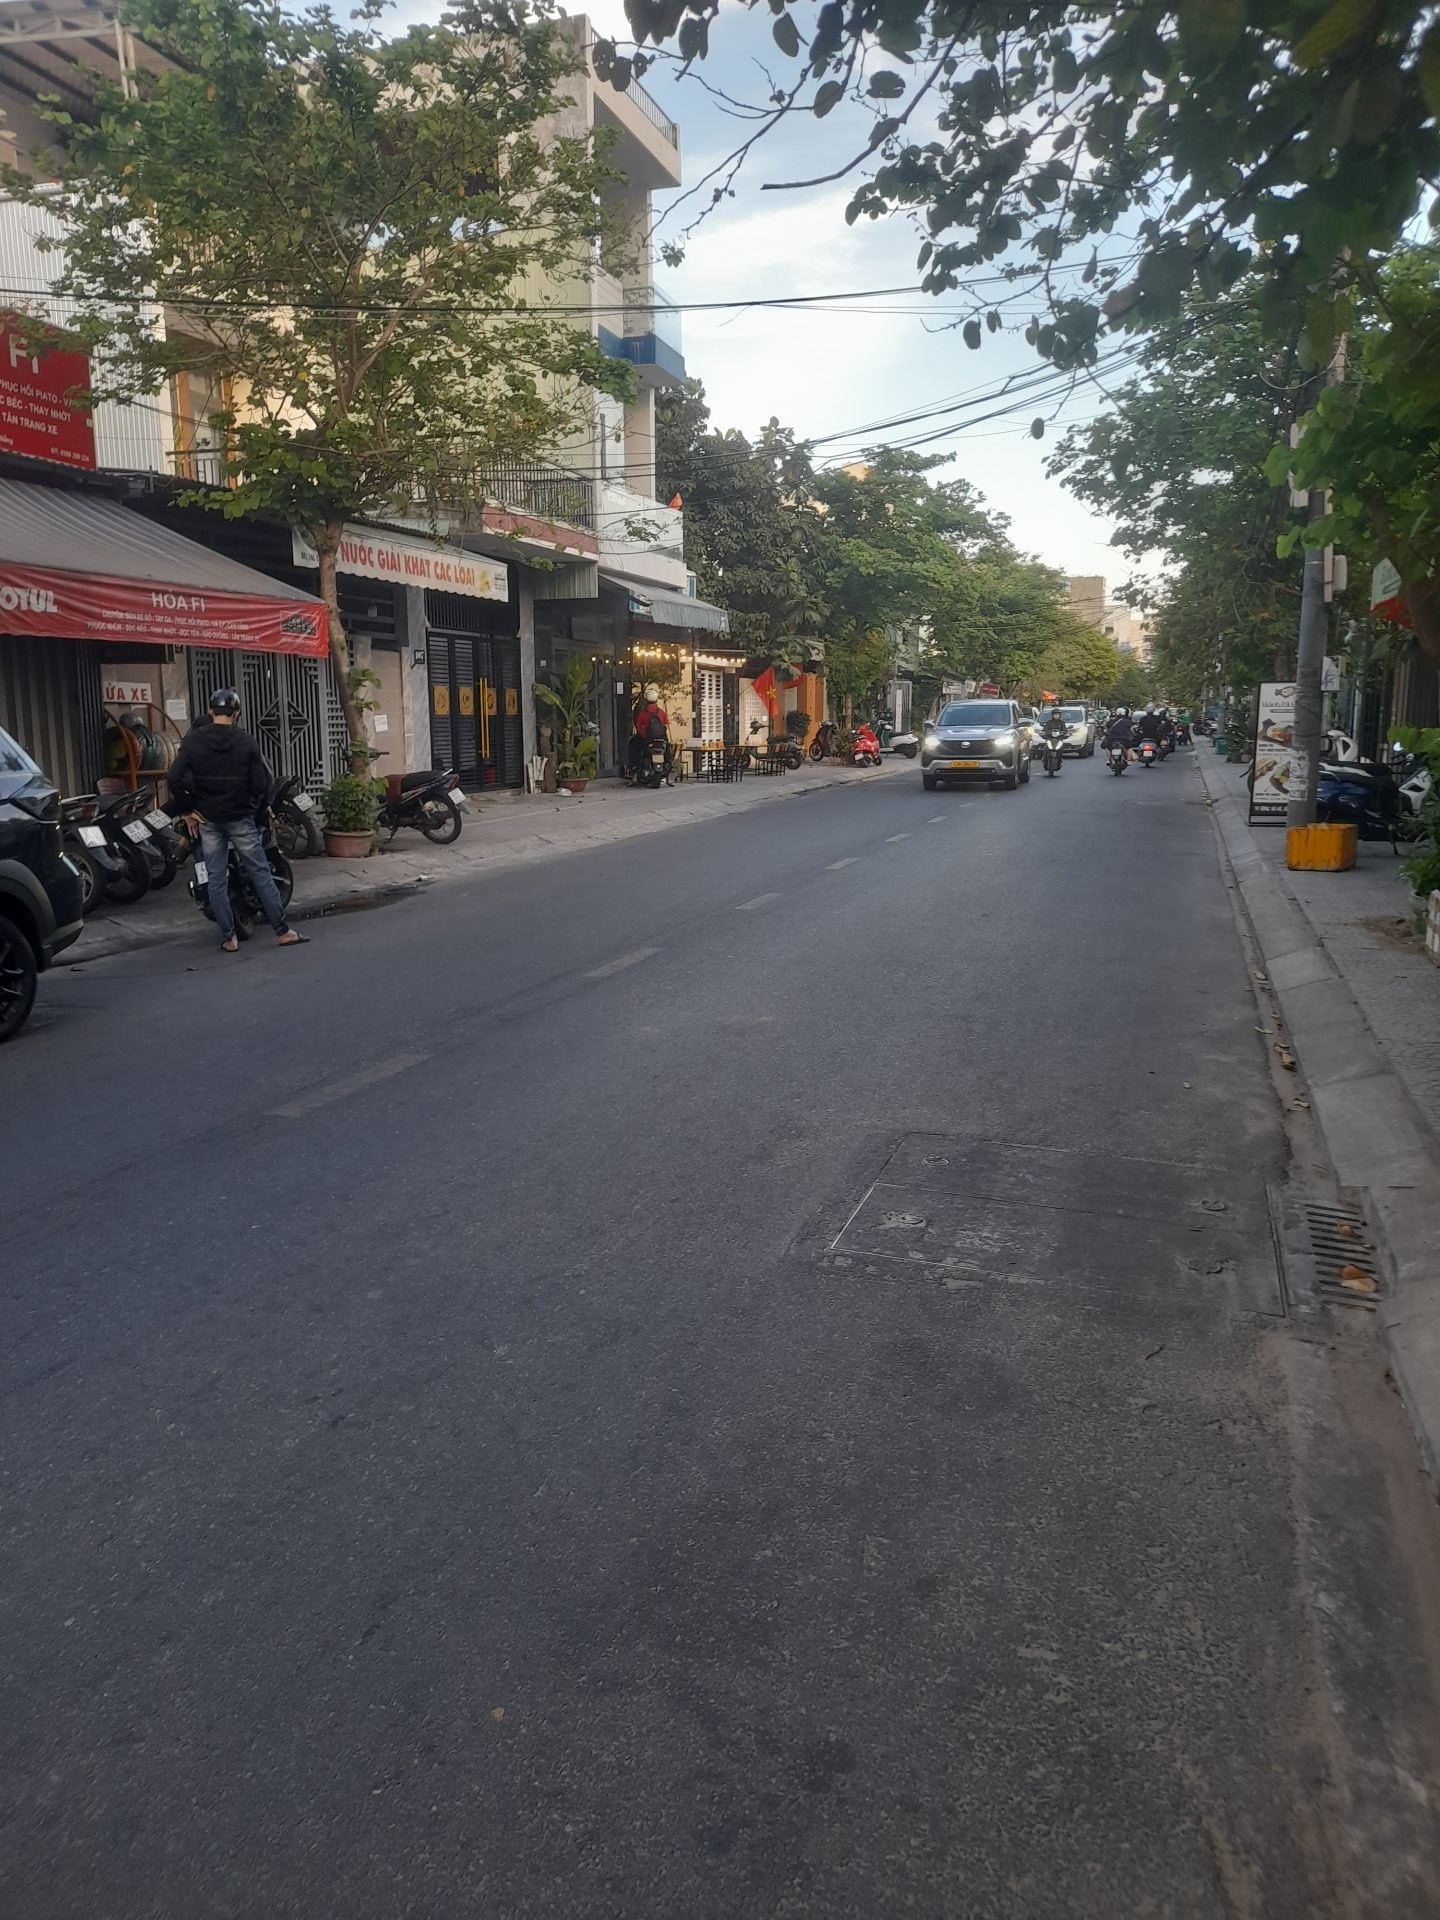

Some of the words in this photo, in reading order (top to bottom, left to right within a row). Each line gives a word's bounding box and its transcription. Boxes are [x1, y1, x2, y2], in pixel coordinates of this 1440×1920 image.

[20, 384, 34, 397] HỒI
[35, 389, 58, 404] PIATO
[29, 402, 49, 417] THAY
[19, 417, 46, 432] TRANG
[47, 423, 58, 435] XE
[404, 553, 431, 578] KHÁT
[191, 596, 206, 613] FI
[131, 687, 149, 702] XE
